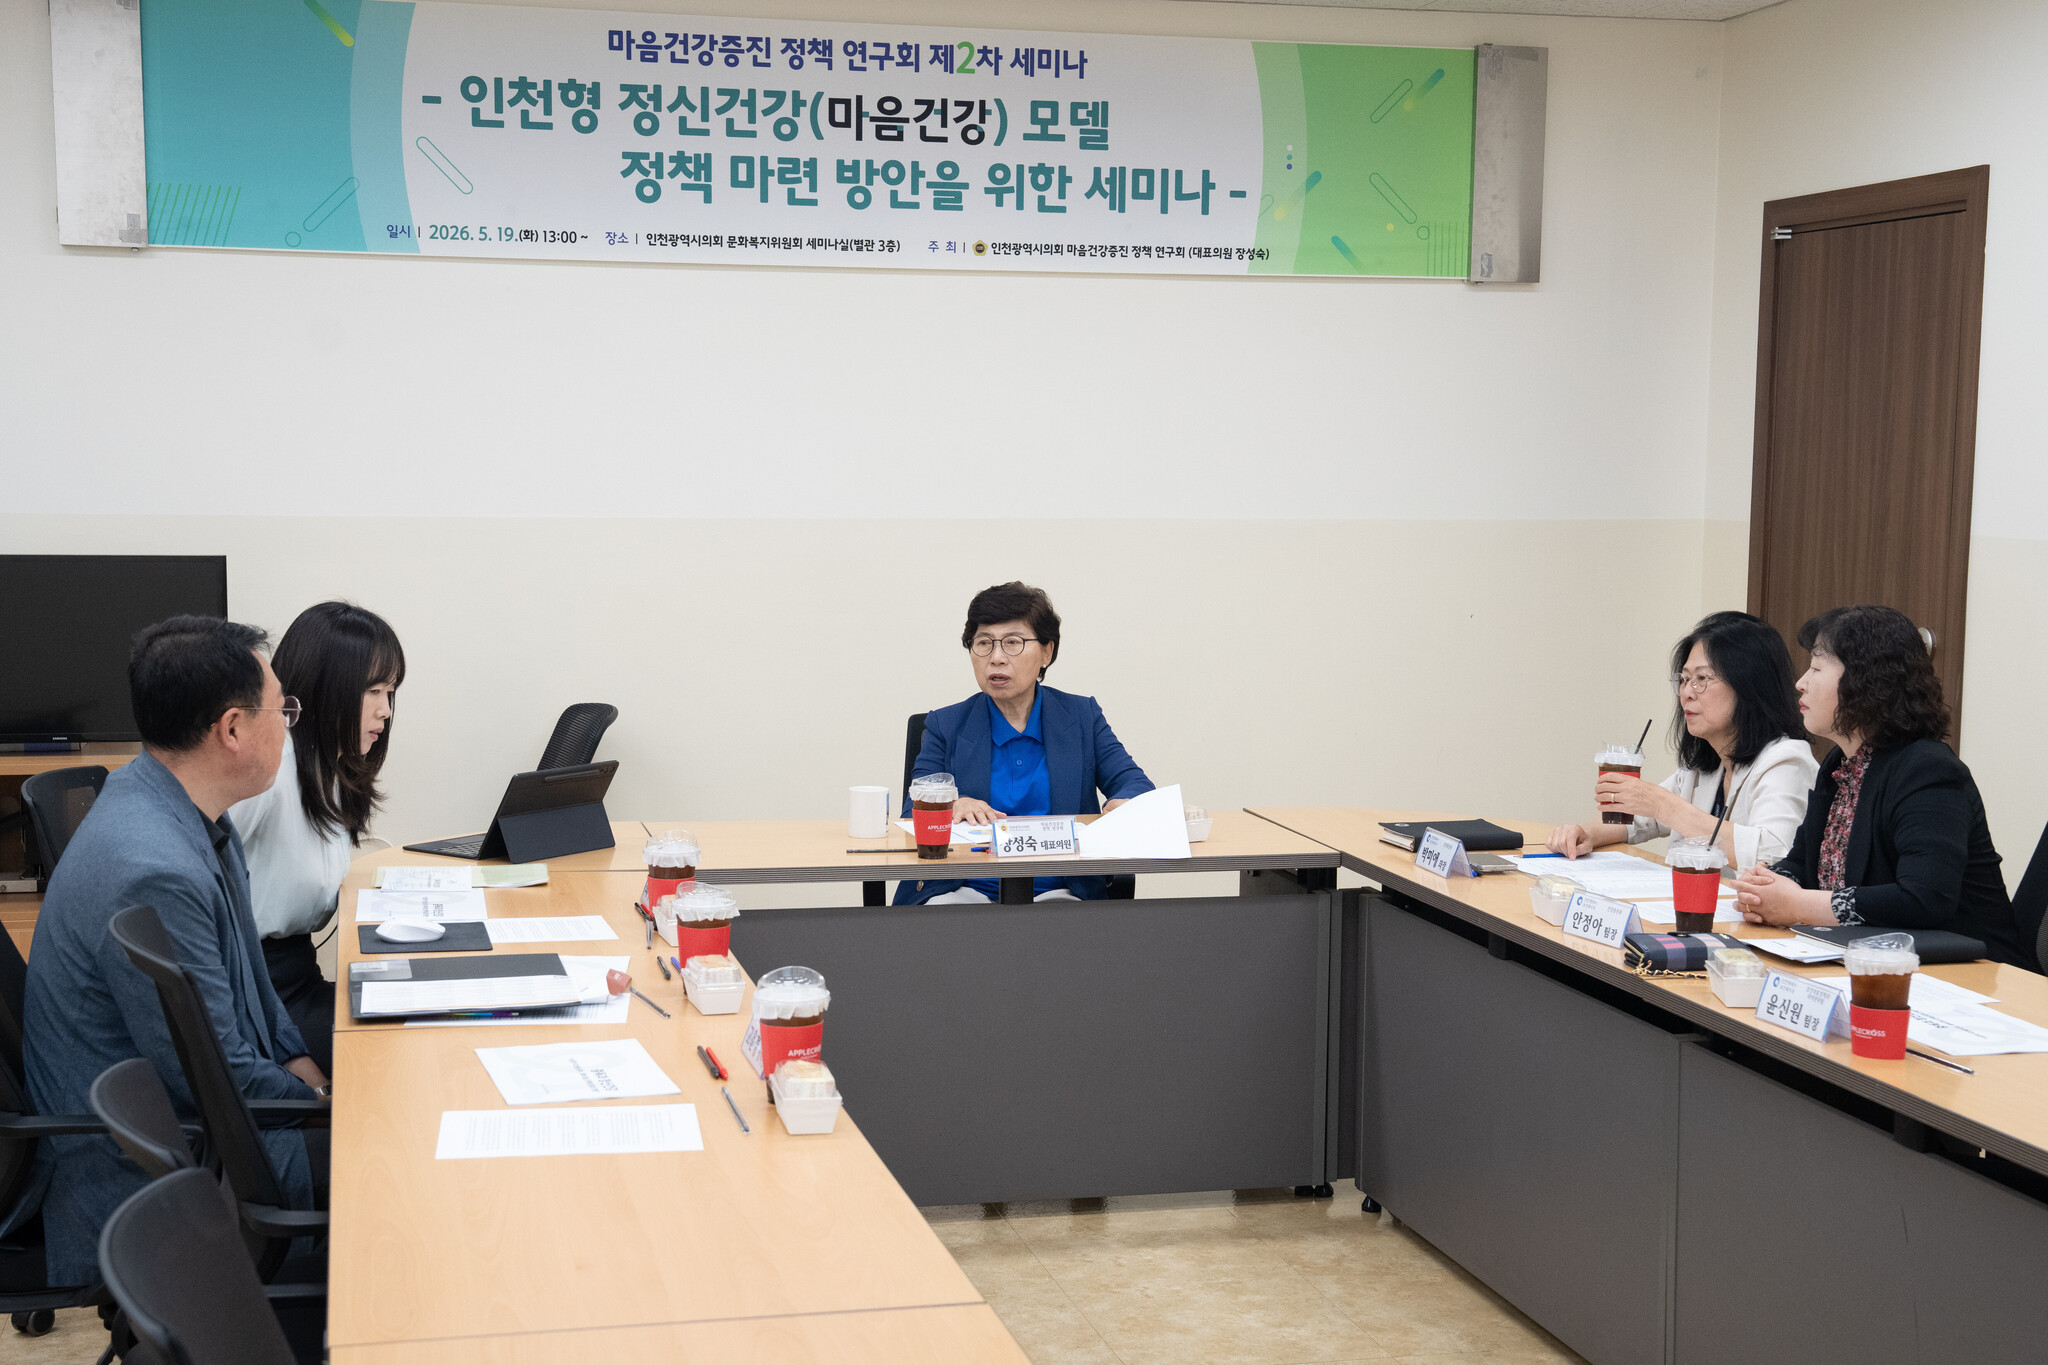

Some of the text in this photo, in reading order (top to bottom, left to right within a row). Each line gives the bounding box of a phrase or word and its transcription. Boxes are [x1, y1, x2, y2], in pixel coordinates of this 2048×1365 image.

[608, 29, 1088, 79] 마음건강증진 정책 연구회 제2차 세미나
[460, 75, 601, 135] 인천형
[618, 83, 1008, 147] 정신건강(마음건강)
[1023, 99, 1109, 151] 모델
[620, 150, 713, 204] 정책
[730, 155, 819, 207] 마련
[836, 158, 970, 212] 방안을
[984, 162, 1073, 214] 위한
[1084, 166, 1216, 216] 세미나
[386, 224, 411, 239] 일시
[430, 225, 474, 241] 2026.
[479, 227, 492, 242] 5.
[542, 230, 577, 244] 13:00
[605, 232, 901, 253] 장소 인천광역시의회 문화복지위원회 세미나실(별관 3층)
[991, 243, 1064, 257] 인천광역시의회
[1067, 244, 1129, 259] 마음건강증진
[1132, 245, 1152, 259] 정책
[1155, 246, 1186, 260] 연구회
[1188, 247, 1233, 261] (대표의원
[1236, 247, 1270, 263] 장성숙)
[1040, 839, 1072, 851] 대표의원
[1573, 911, 1618, 940] 안정아 팀장
[1766, 994, 1803, 1025] 윤신원
[1804, 1014, 1820, 1032] 팀장
